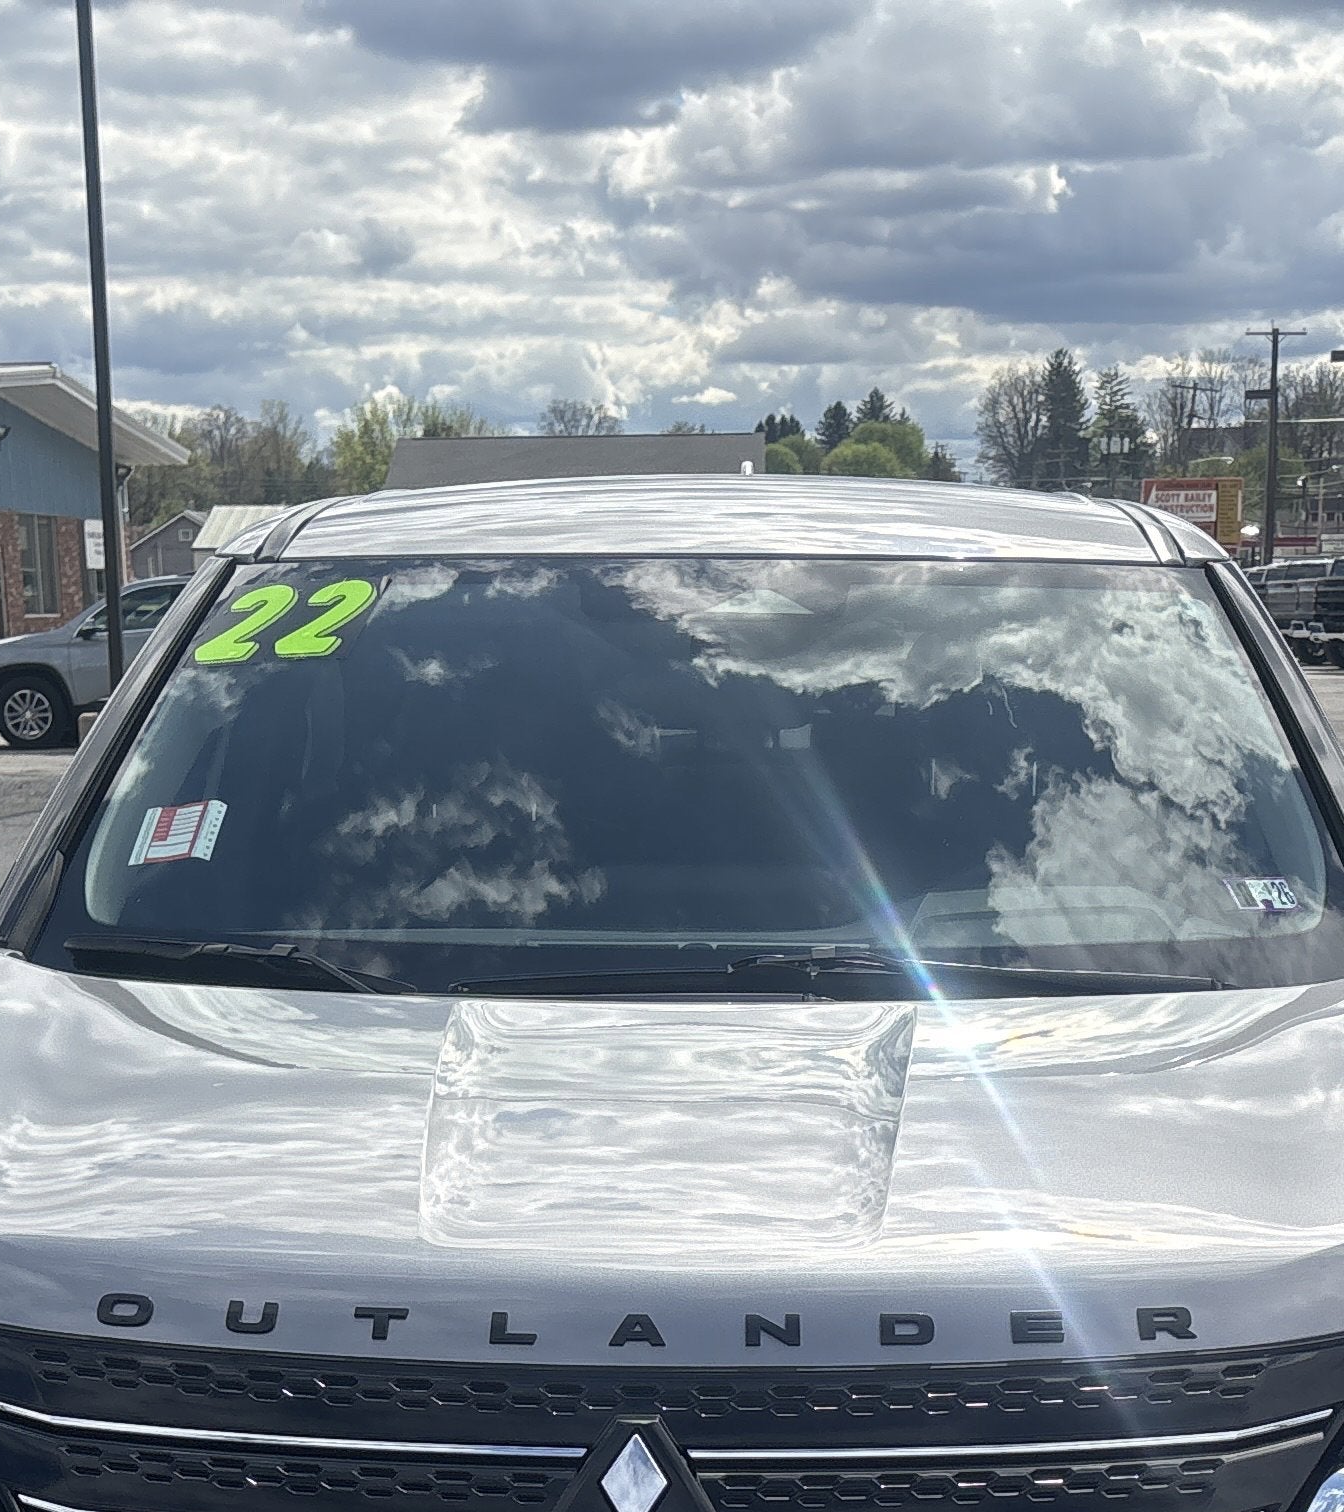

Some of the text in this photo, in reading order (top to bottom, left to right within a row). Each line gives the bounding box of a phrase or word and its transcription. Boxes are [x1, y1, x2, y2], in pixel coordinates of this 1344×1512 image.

[1155, 492, 1181, 503] SCOTT
[194, 579, 378, 665] 22
[1270, 881, 1296, 905] 26
[97, 1292, 1198, 1347] OUTLANDER
